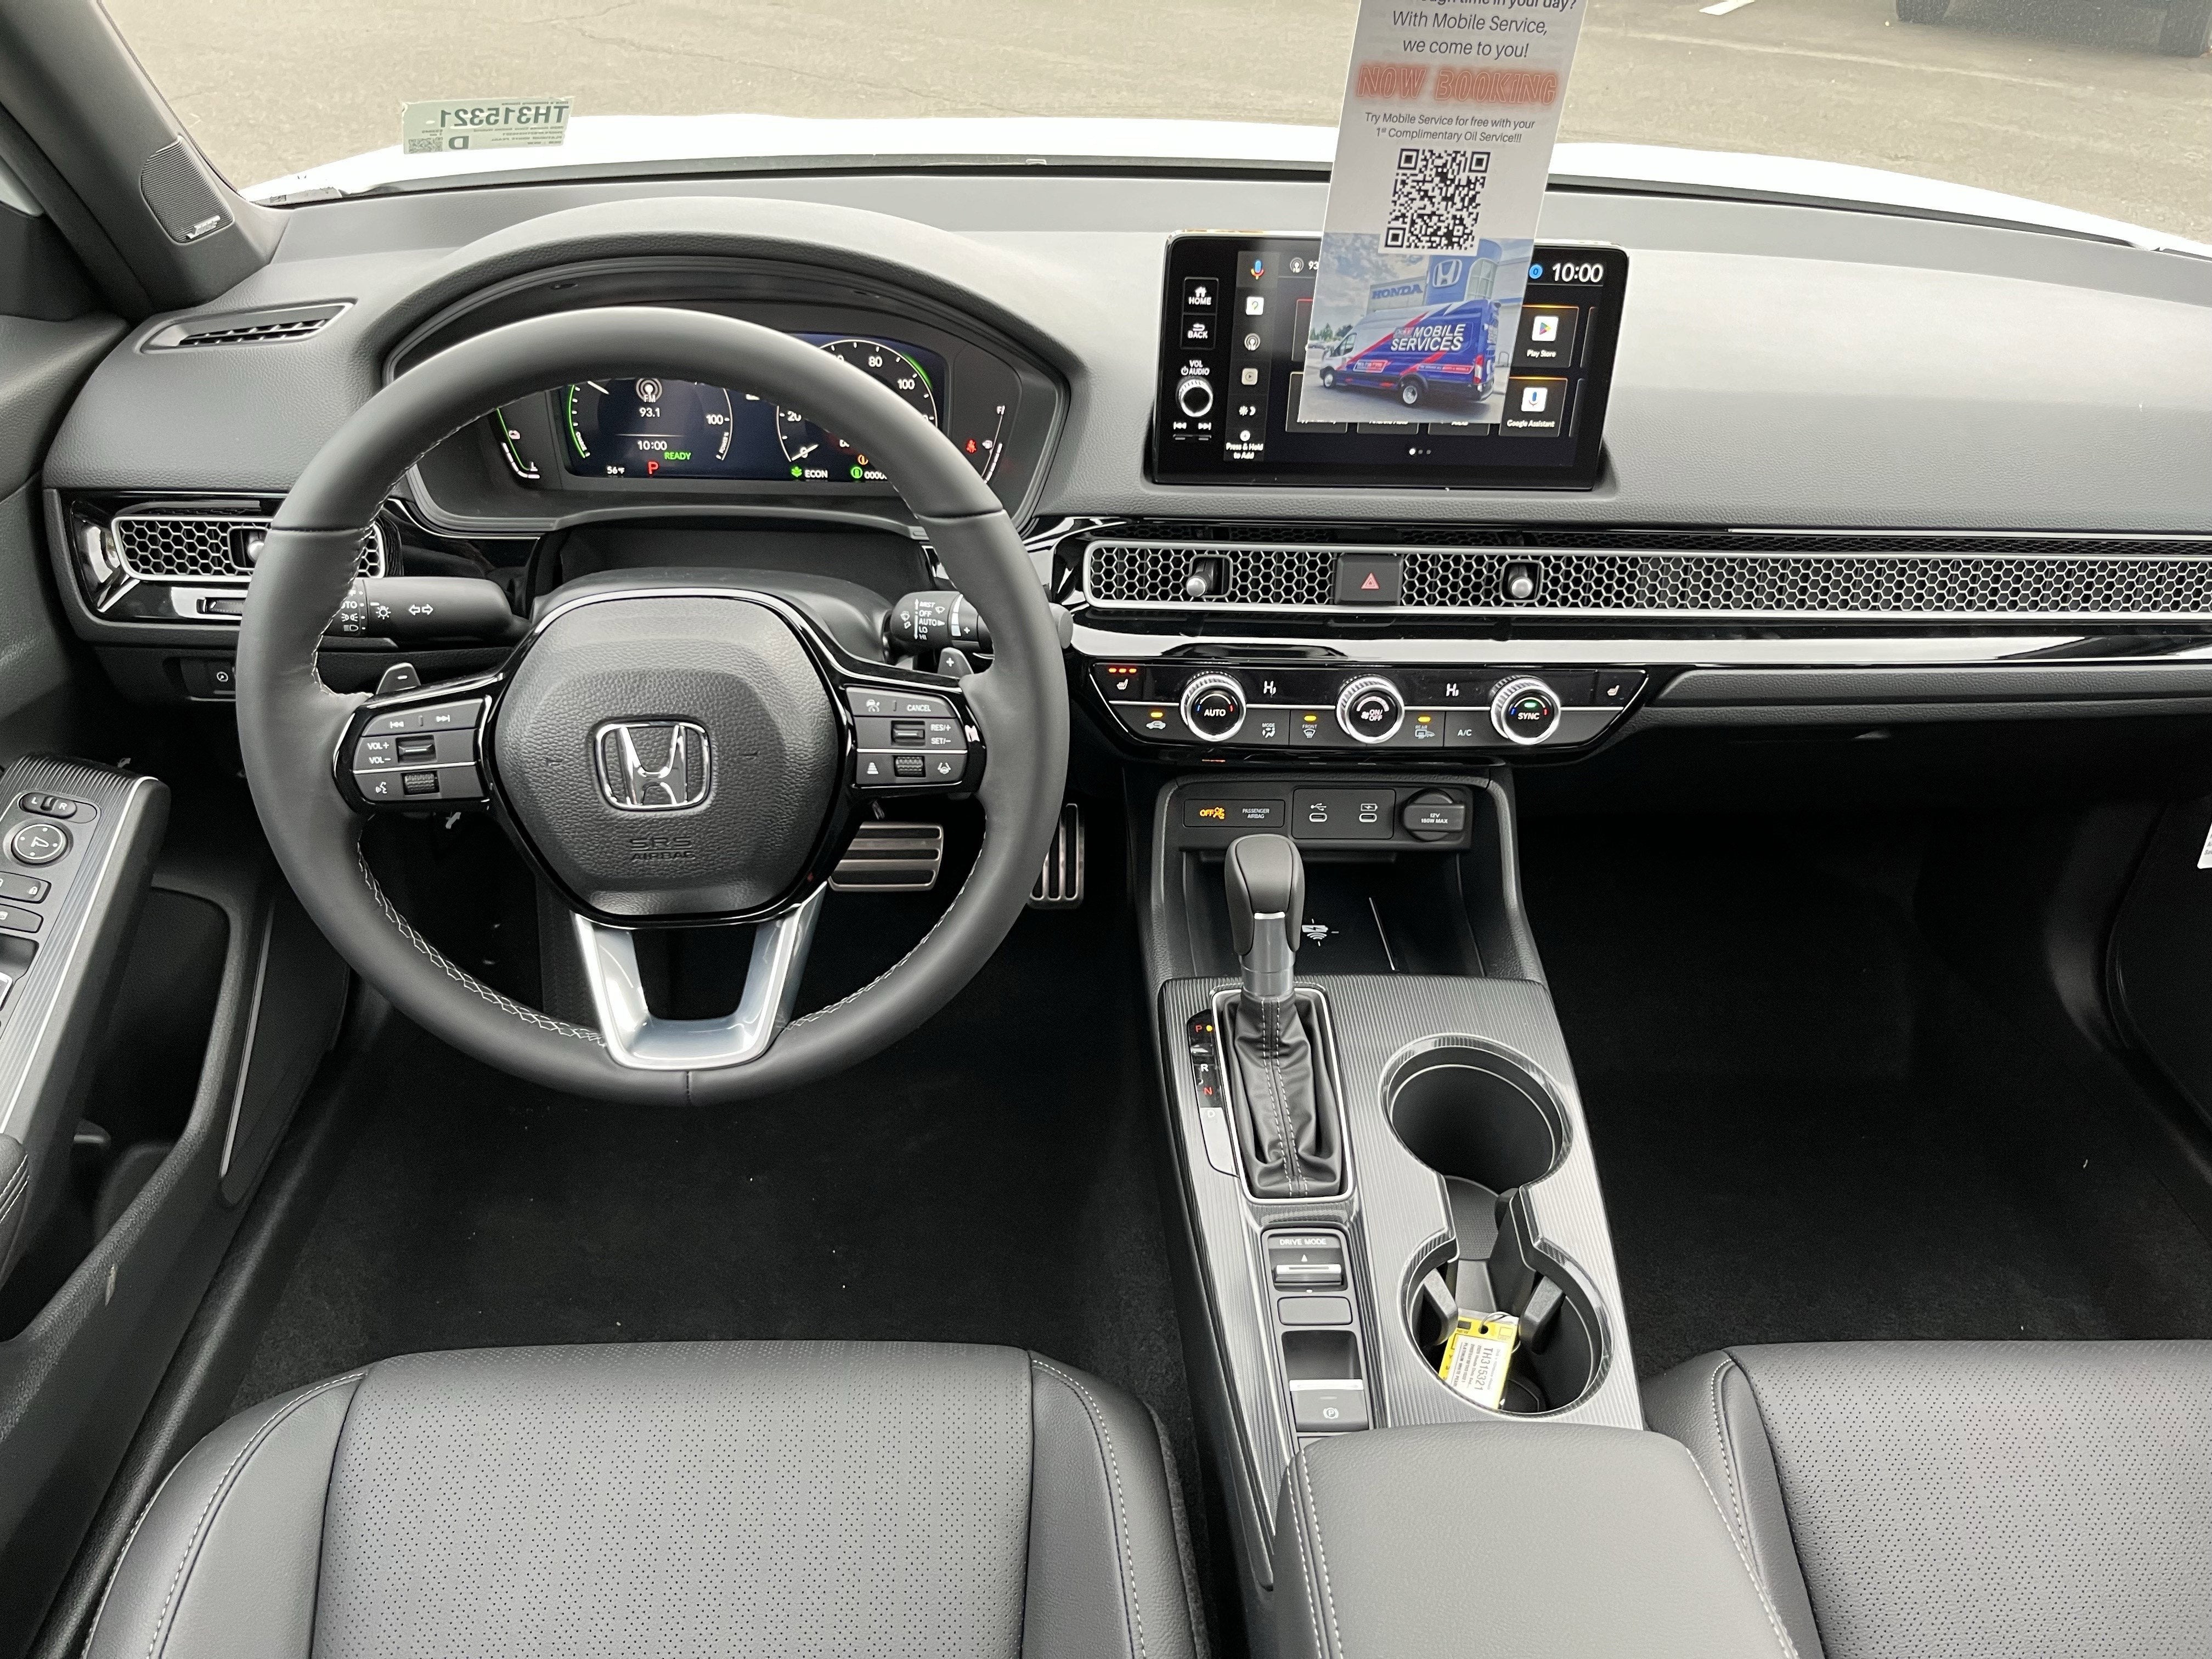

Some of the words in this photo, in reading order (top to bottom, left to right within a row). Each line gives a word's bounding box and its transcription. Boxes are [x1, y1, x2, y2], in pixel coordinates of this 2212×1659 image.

[1393, 10, 1428, 27] With
[1432, 13, 1486, 30] Mobile
[1489, 15, 1548, 36] Service,
[1403, 40, 1426, 53] we
[1429, 41, 1472, 55] come
[1476, 42, 1492, 55] to
[1494, 43, 1529, 60] you!
[1356, 66, 1426, 99] NOW
[1434, 70, 1558, 105] BOOKING
[1365, 112, 1380, 125] Try
[1383, 113, 1416, 125] Mobile
[1418, 115, 1454, 126] Service
[1455, 115, 1470, 126] for
[1470, 116, 1488, 127] free
[1491, 117, 1511, 128] with
[1513, 120, 1536, 131] your
[1388, 128, 1463, 143] Complimentary
[1464, 131, 1477, 141] Oil
[1479, 132, 1522, 143] Service!!!
[1552, 263, 1604, 283] 10:00
[1372, 284, 1423, 299] HONDA
[1188, 297, 1211, 305] HOME
[1413, 324, 1466, 338] MOBILE
[1391, 336, 1464, 352] SERVICES
[1527, 349, 1540, 358] Play
[868, 356, 883, 367] 80
[897, 379, 915, 390] 100
[639, 407, 660, 417] 93.1
[706, 414, 724, 425] 100
[1507, 420, 1527, 428] Google
[637, 440, 668, 450] 10:00
[664, 452, 692, 460] READY
[647, 461, 658, 475] P
[804, 469, 828, 478] ECON
[59, 802, 67, 810] R
[631, 851, 696, 860] AIRBAG
[1195, 1025, 1203, 1033] P
[1200, 1064, 1209, 1072] R
[1203, 1087, 1213, 1095] N
[1207, 1109, 1216, 1118] D
[1474, 1348, 1493, 1390] TH315321
